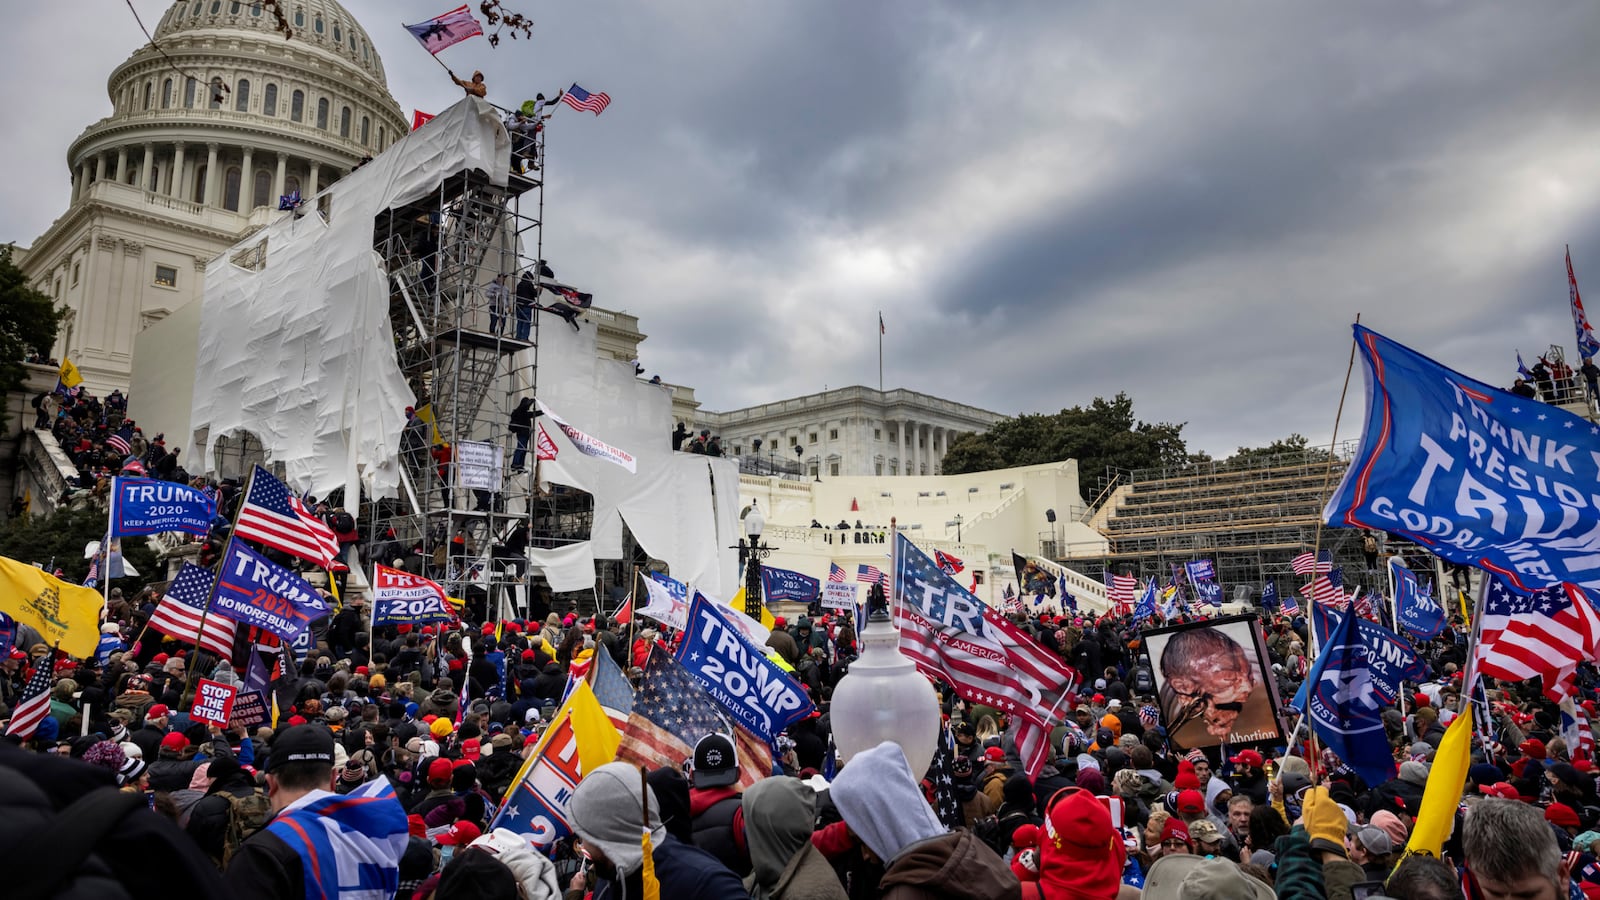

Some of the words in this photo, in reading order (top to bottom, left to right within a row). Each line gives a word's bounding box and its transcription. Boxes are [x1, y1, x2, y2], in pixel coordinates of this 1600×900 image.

[1445, 377, 1577, 475] THANK
[586, 444, 622, 464] Republicans
[587, 437, 604, 449] FOR
[606, 445, 633, 462] TRUMP
[124, 519, 144, 527] KEEP
[146, 516, 180, 526] AMERICA
[182, 517, 207, 528] GREAT!
[1370, 496, 1453, 537] GOD
[251, 588, 295, 619] 2020
[381, 590, 403, 598] KEEP
[217, 595, 234, 609] NO
[234, 601, 268, 620] MORE
[909, 613, 949, 645] MAKING
[951, 640, 1007, 665] AMERICA
[701, 608, 802, 715] TRUMP
[201, 684, 231, 699] STOP
[203, 695, 225, 710] THE
[193, 704, 227, 723] STEAL
[708, 687, 757, 726] AMERICA
[1230, 729, 1276, 744] Abortion
